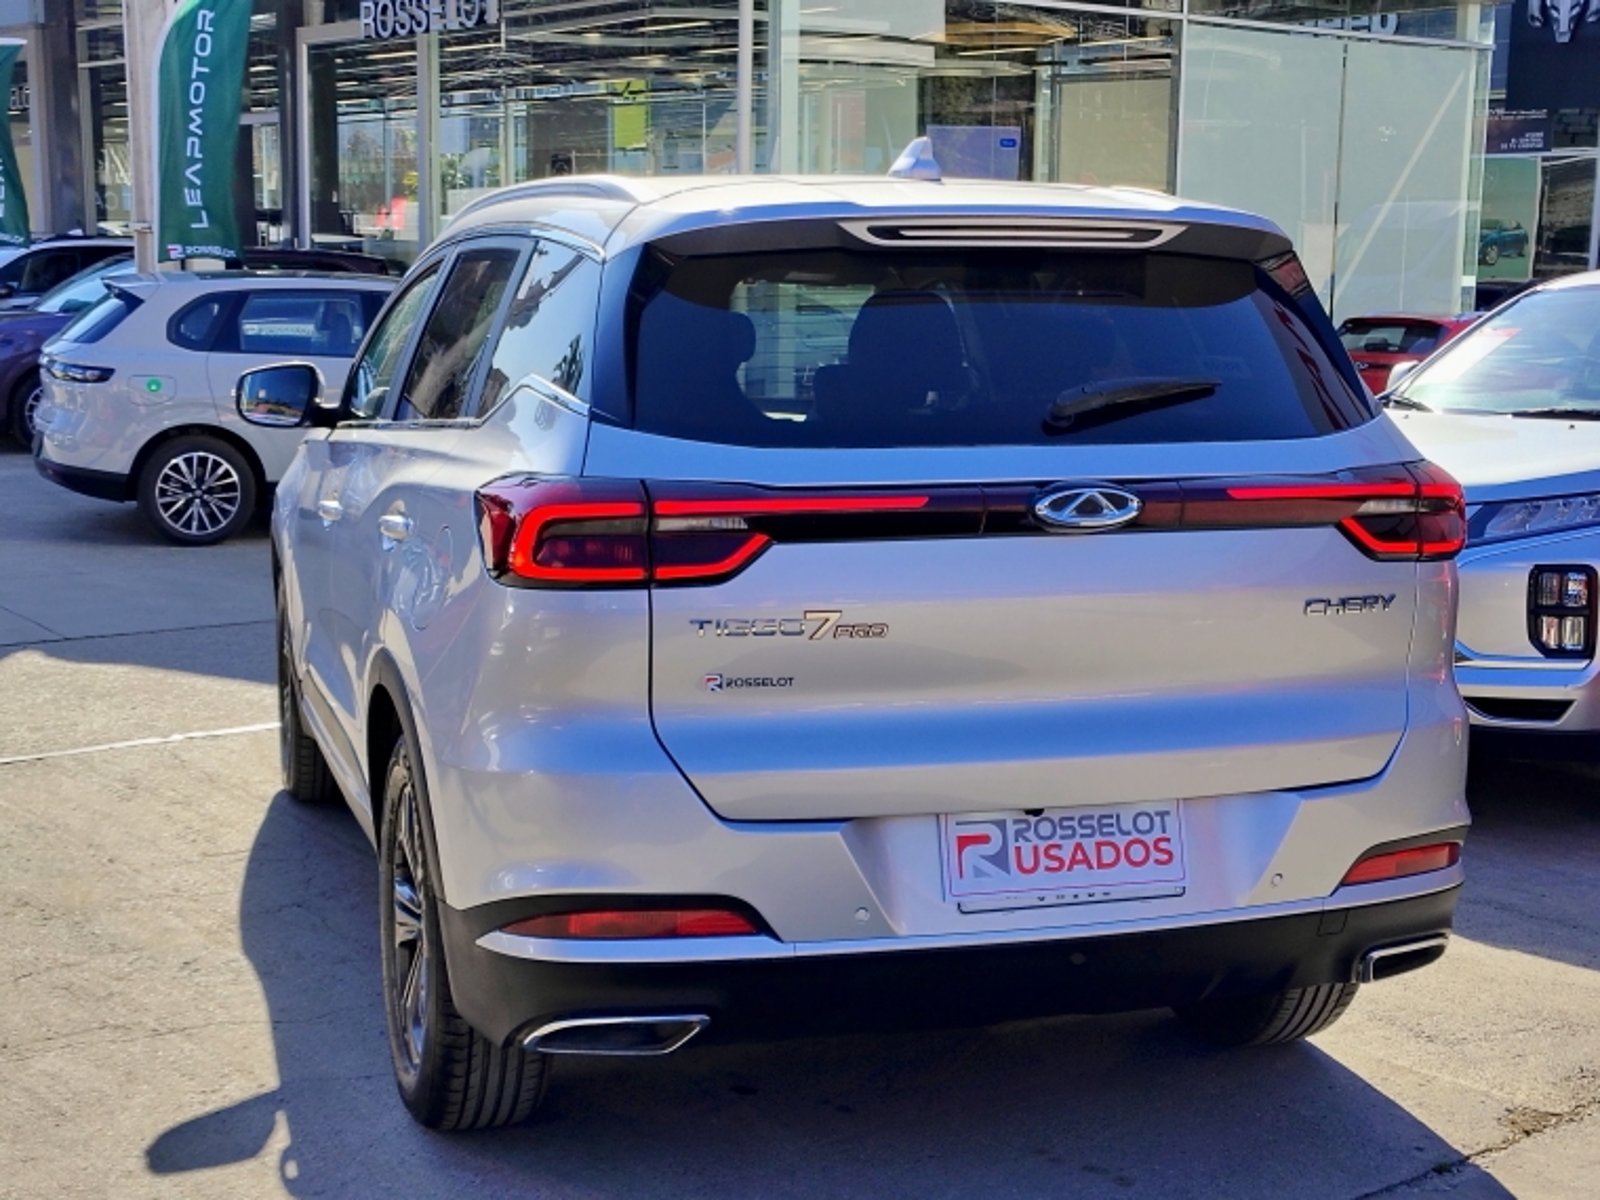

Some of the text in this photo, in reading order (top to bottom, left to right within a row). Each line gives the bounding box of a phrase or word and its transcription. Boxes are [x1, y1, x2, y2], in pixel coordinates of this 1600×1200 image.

[359, 0, 499, 38] ROSSELOT
[184, 9, 215, 228] LEAPMOTOR
[1303, 593, 1396, 615] CHERY
[726, 676, 795, 688] ROSSELOT
[1012, 810, 1171, 843] ROSSELOT
[1014, 837, 1174, 875] USADOS
